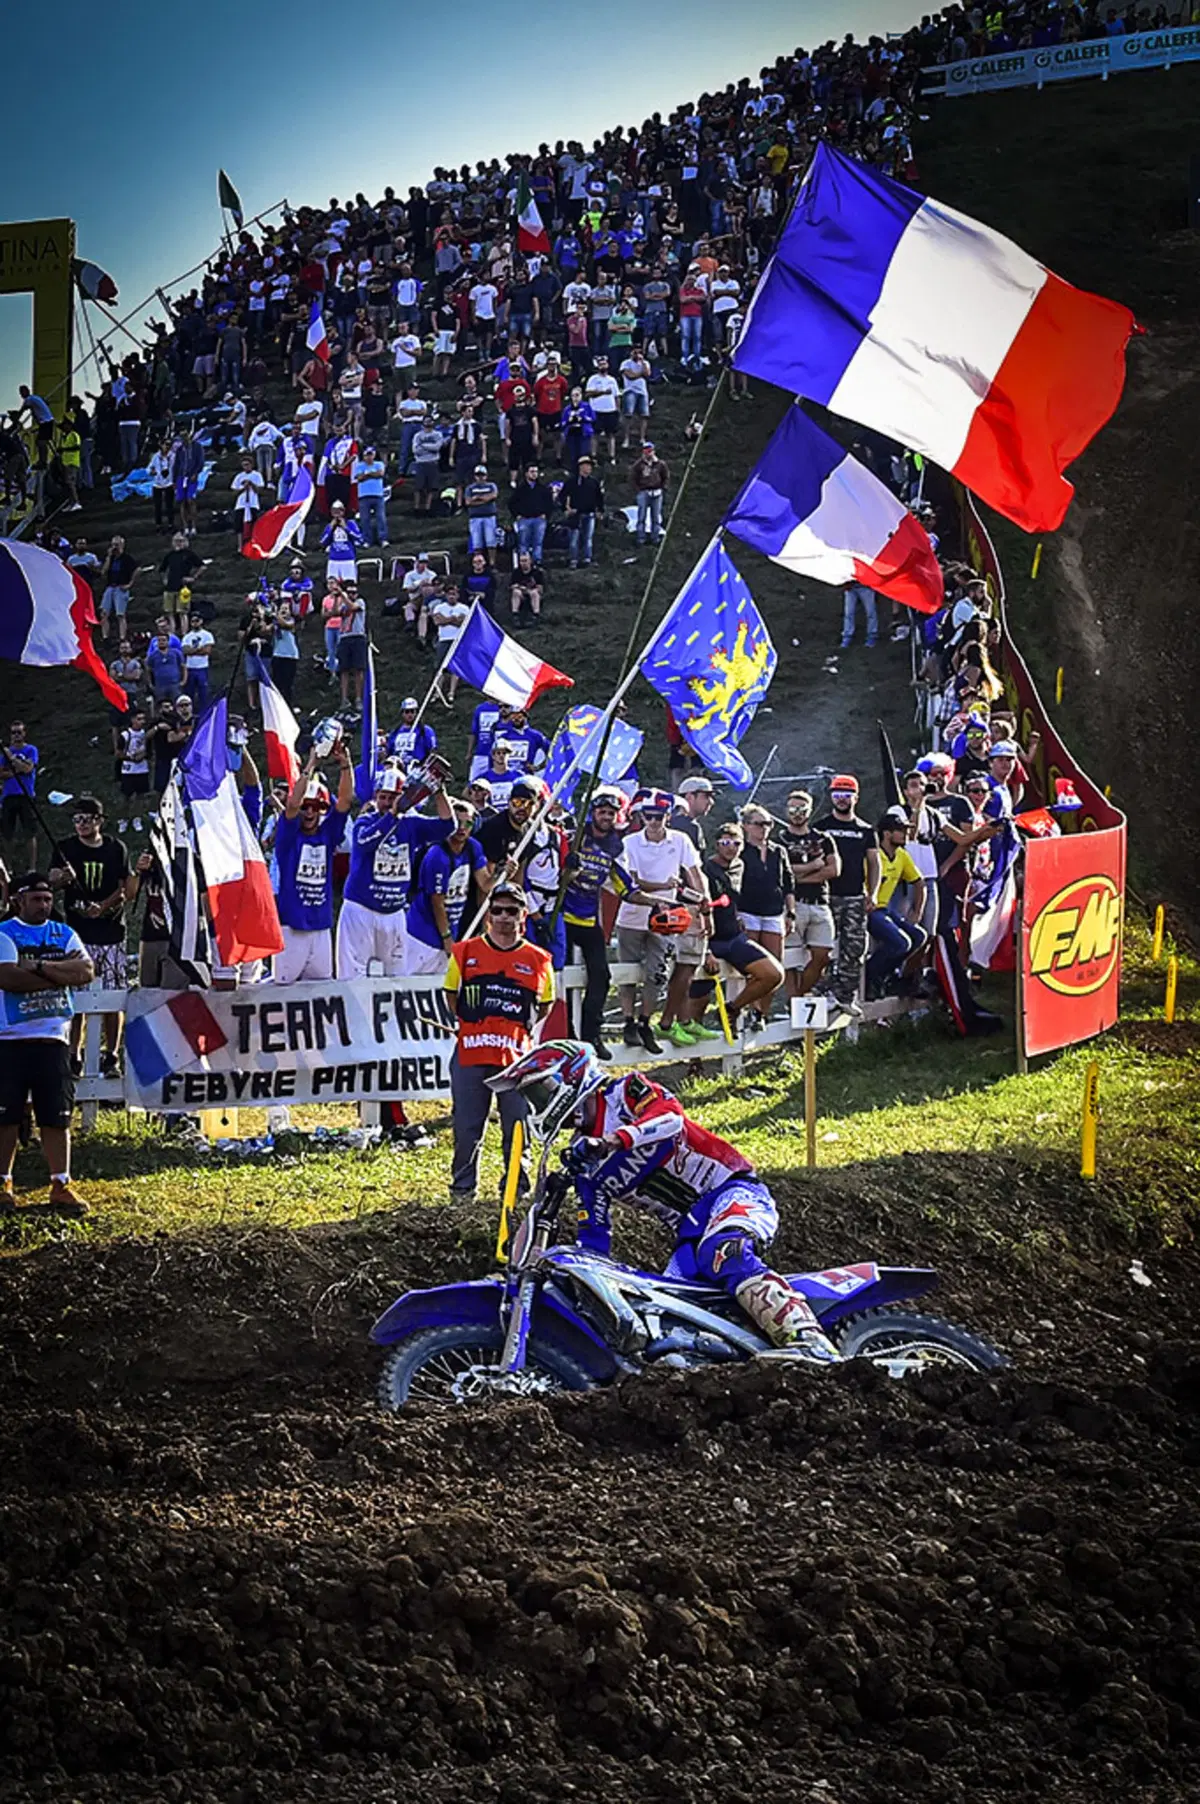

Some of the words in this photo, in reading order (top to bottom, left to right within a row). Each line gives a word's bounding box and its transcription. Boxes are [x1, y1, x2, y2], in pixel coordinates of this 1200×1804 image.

[971, 56, 1025, 76] CALEFFI
[1054, 43, 1110, 64] CALEFFI
[1030, 887, 1121, 976] FMF
[231, 996, 352, 1054] TEAM
[804, 1003, 817, 1024] 7
[312, 1055, 451, 1095] PATUREL
